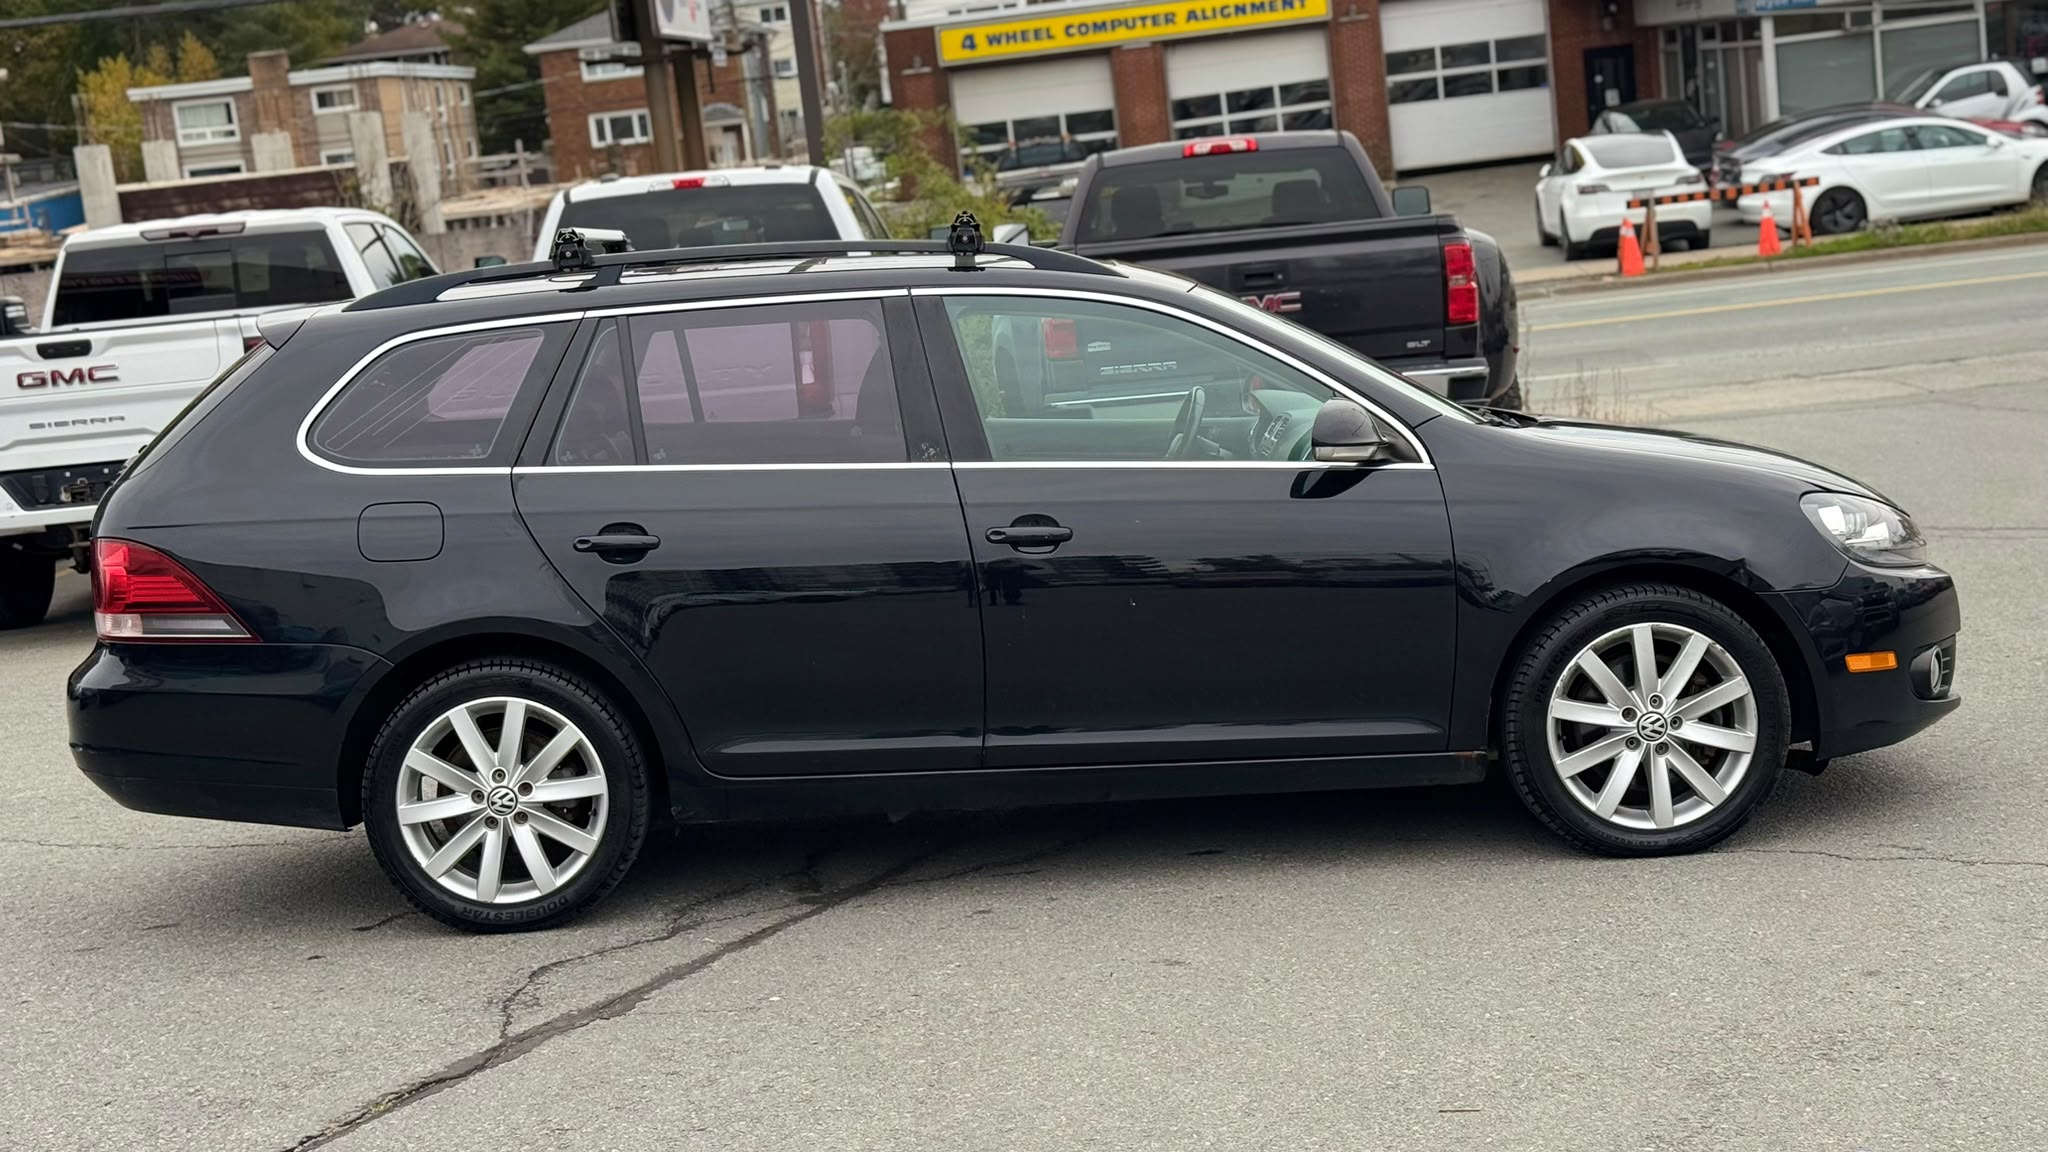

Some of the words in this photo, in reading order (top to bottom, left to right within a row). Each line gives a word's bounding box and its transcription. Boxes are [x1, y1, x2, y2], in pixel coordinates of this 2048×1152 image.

[961, 33, 977, 51] 4
[986, 27, 1056, 47] WHEEL
[1064, 12, 1177, 38] COMPUTER
[1241, 291, 1302, 313] MC
[16, 363, 120, 389] GMC
[1100, 361, 1177, 376] SIERRA
[29, 416, 126, 430] SIERRA
[463, 894, 570, 922] DOUBLESTAR
